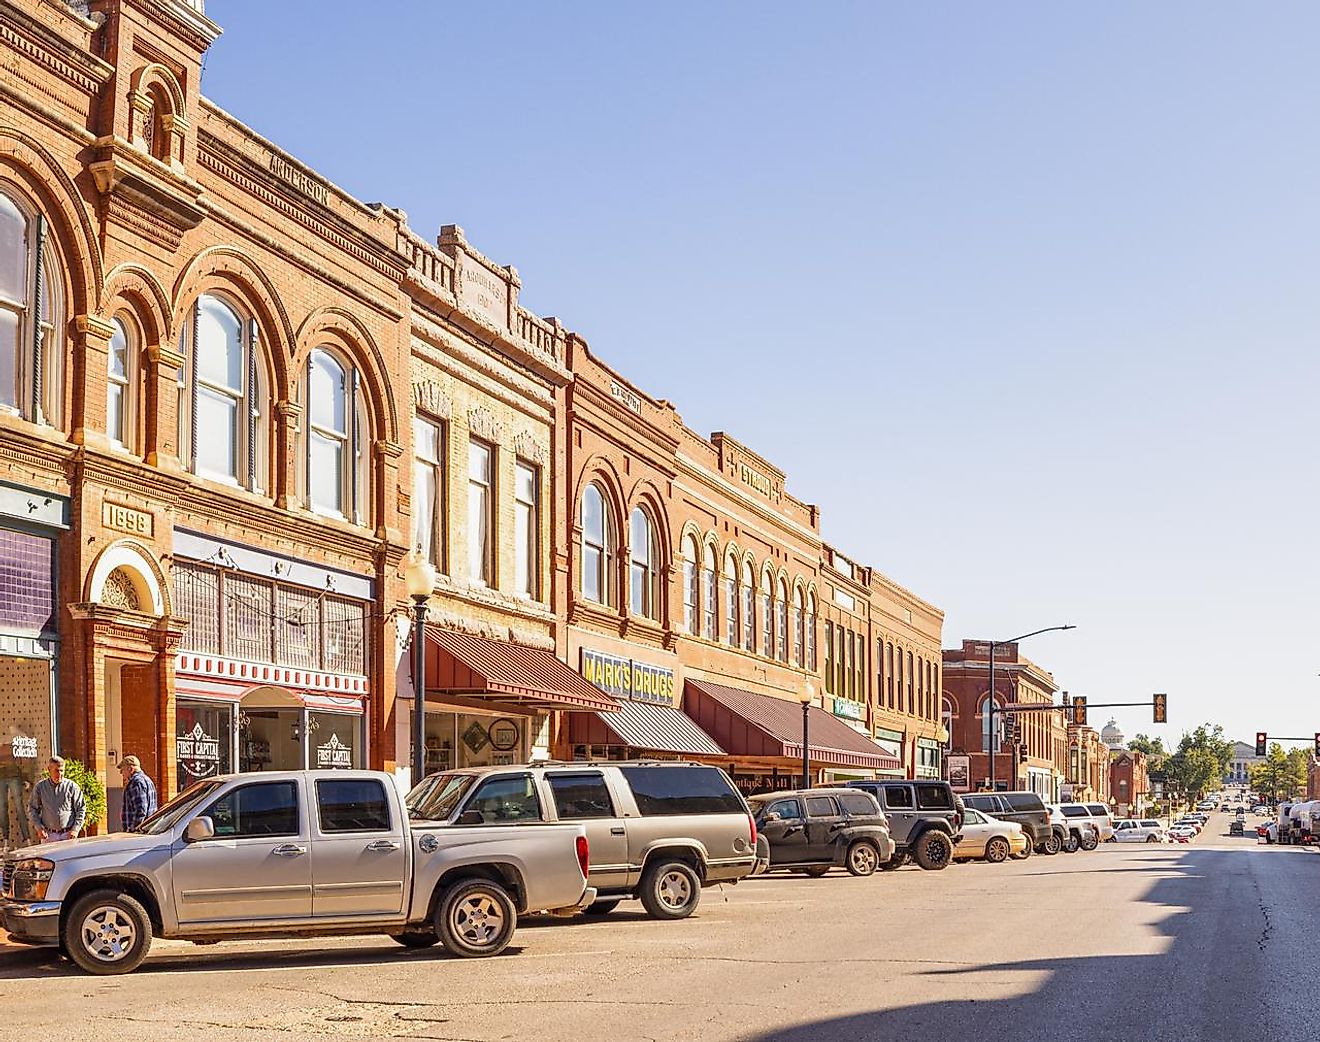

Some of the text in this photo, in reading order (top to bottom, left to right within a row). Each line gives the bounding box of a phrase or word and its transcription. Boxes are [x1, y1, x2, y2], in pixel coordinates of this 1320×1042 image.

[269, 155, 329, 206] ANDERSON
[585, 657, 674, 698] MARK'S DRUGS
[177, 741, 220, 760] FIRST CAPITAL
[317, 749, 352, 766] FIRST CAPITAL
